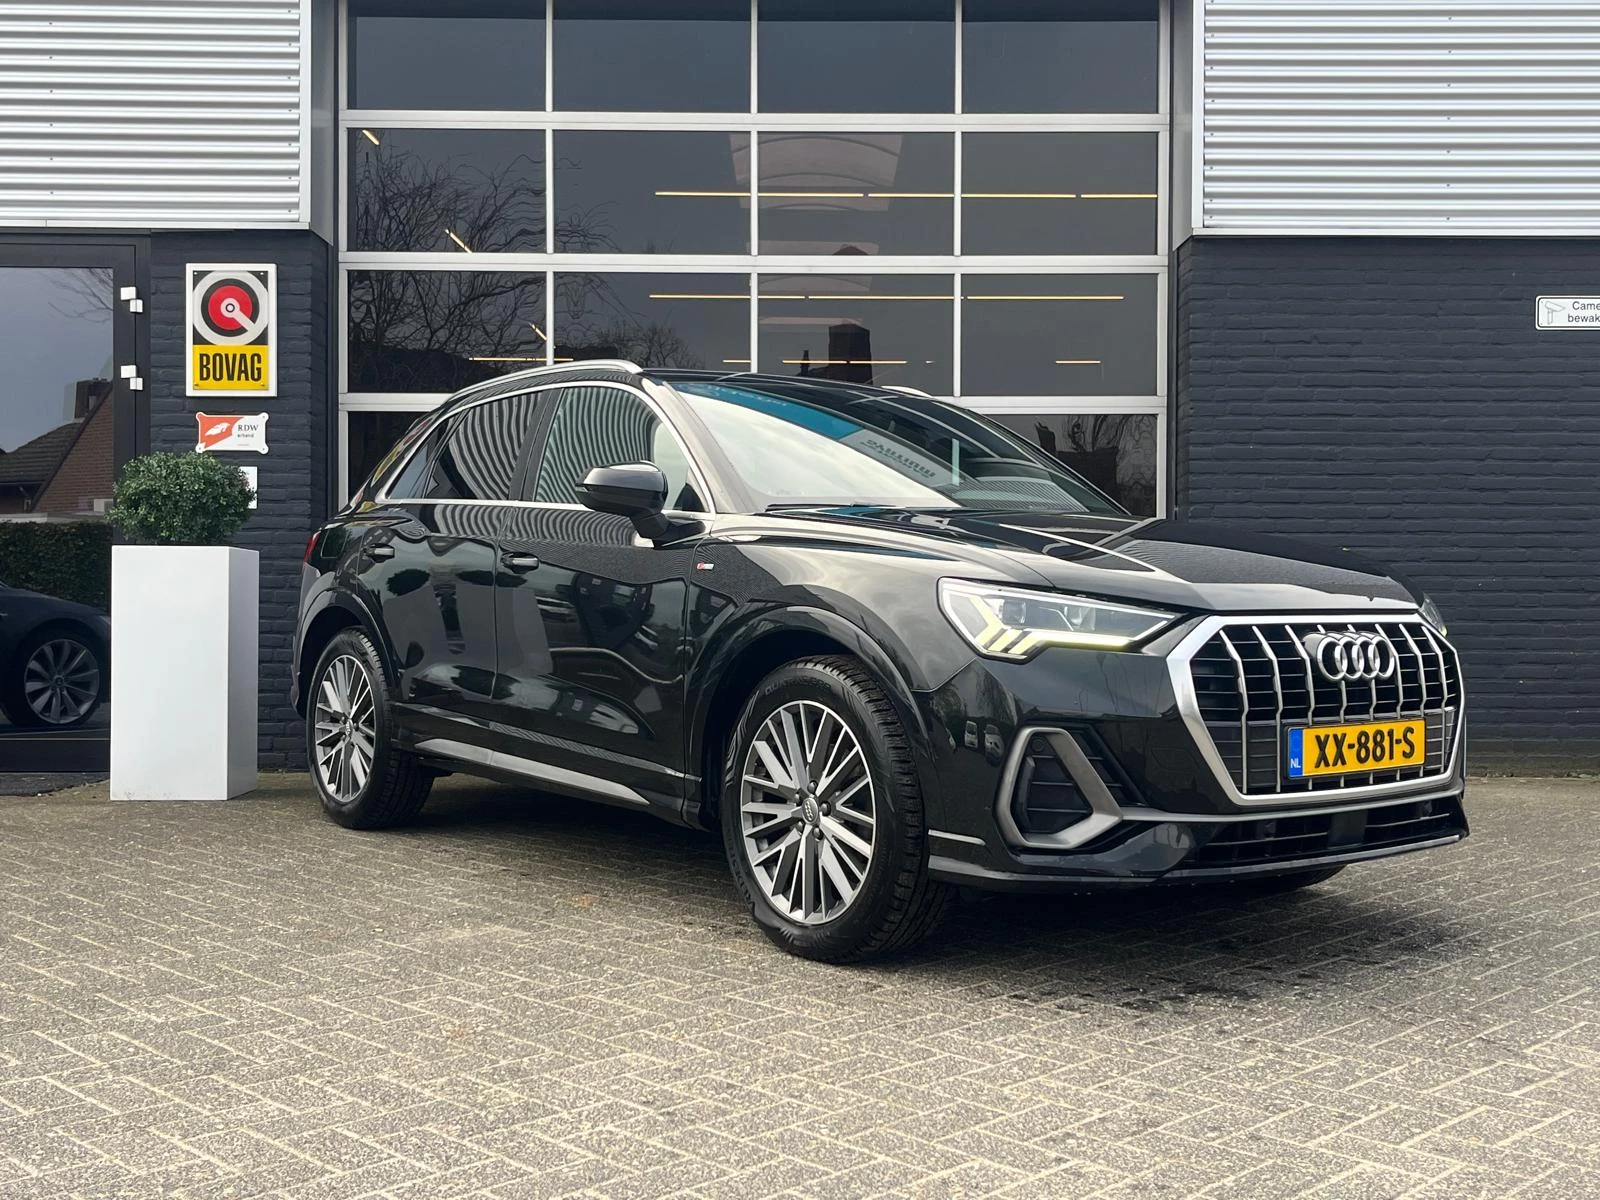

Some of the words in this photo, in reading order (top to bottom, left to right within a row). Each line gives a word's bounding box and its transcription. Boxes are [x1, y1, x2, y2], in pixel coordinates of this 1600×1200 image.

[199, 353, 262, 382] BOVAG
[237, 424, 259, 432] RDW
[1290, 758, 1301, 768] NL
[1314, 726, 1415, 768] XX-881-S
